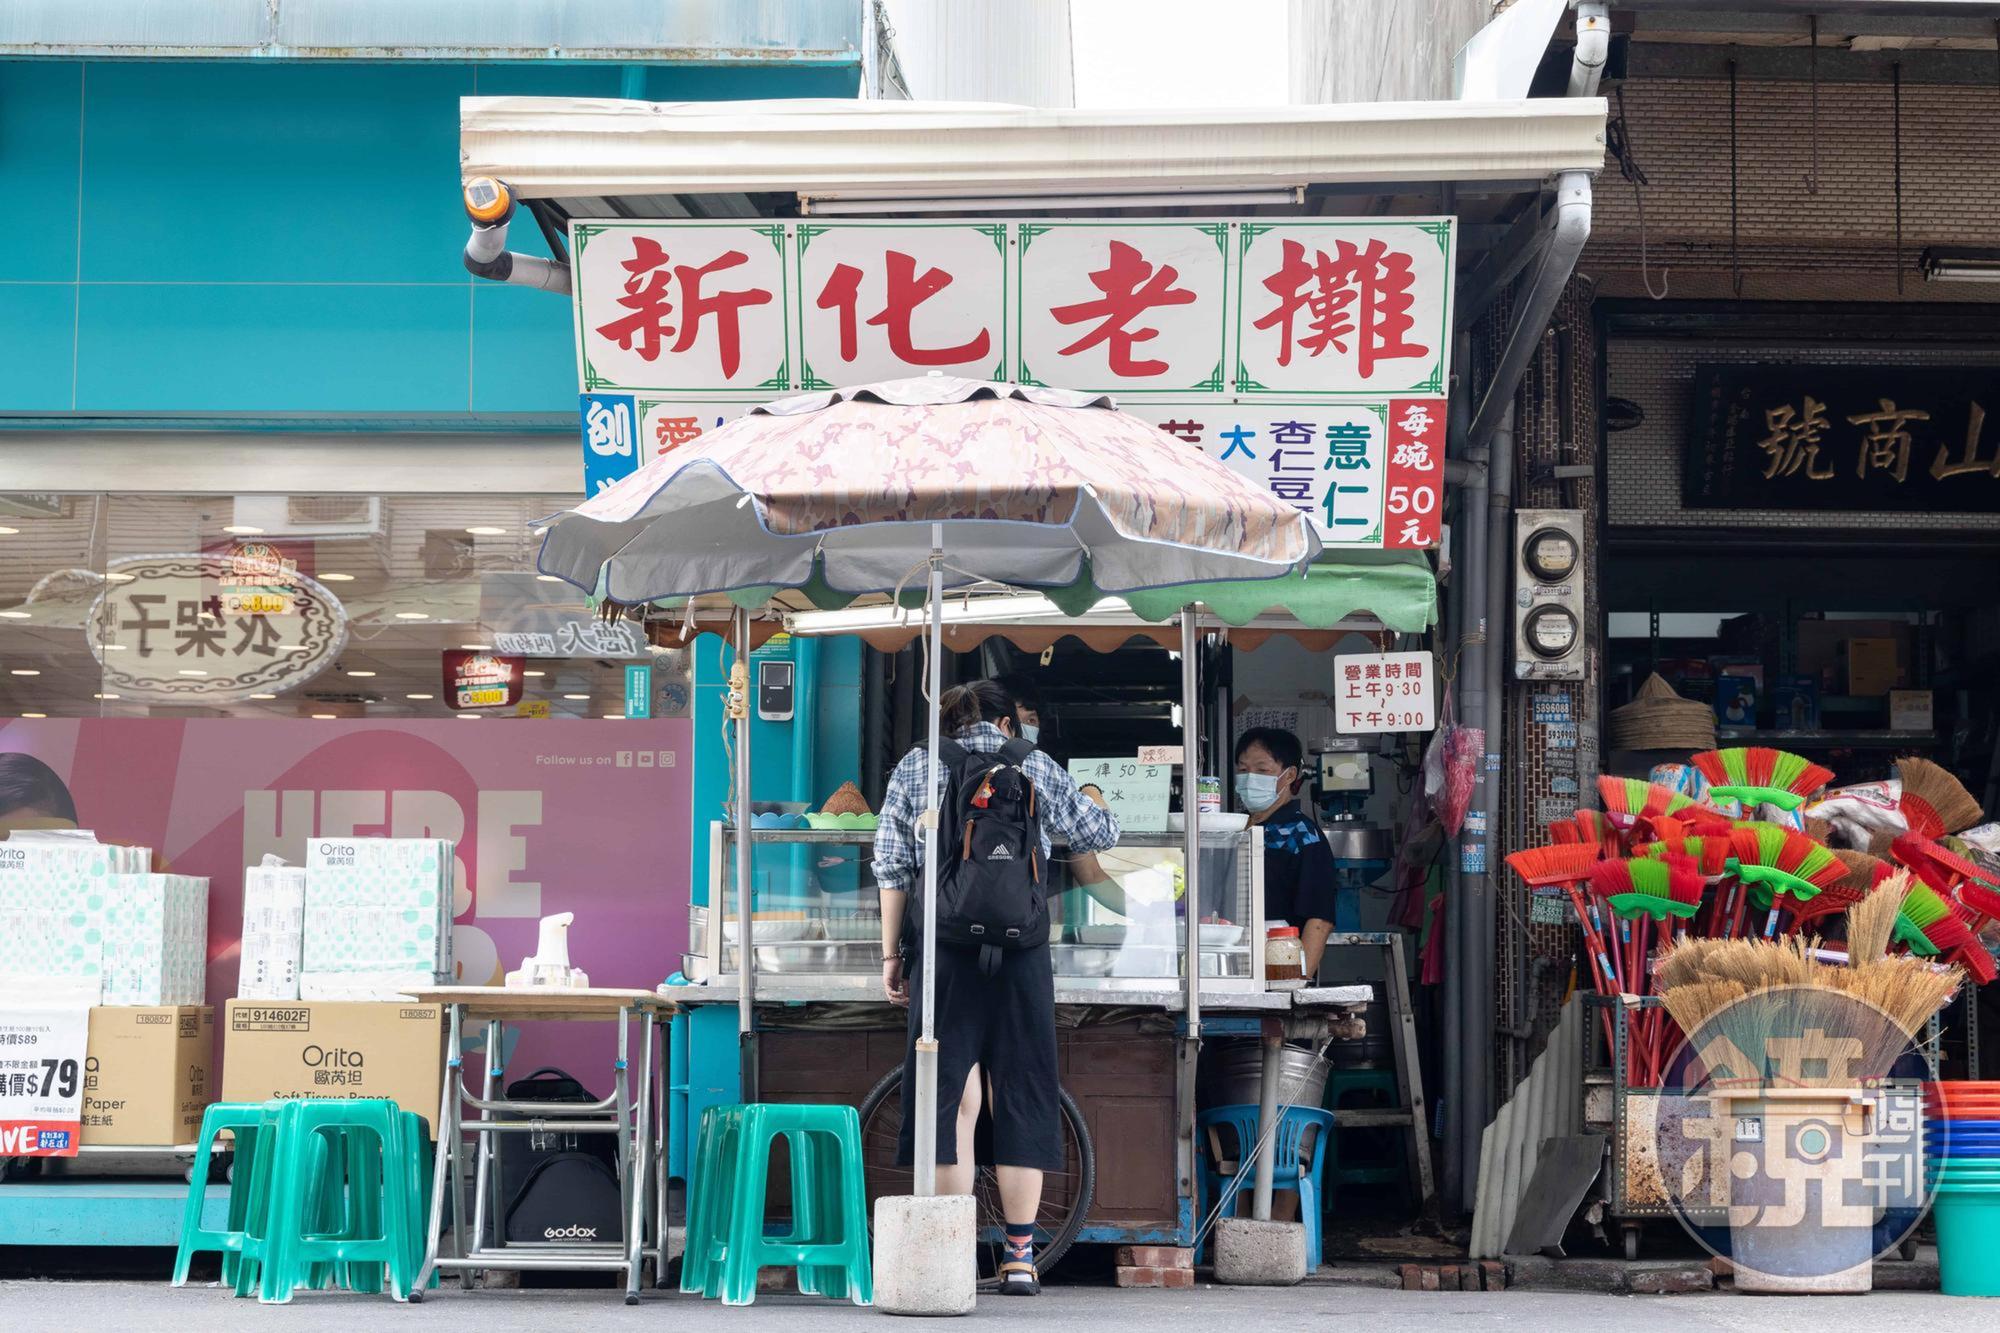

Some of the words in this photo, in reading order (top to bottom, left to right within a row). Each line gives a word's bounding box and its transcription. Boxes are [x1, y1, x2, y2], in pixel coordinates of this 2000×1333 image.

[596, 236, 1430, 381] 新化老攤
[1219, 424, 1256, 461] 大
[1268, 420, 1317, 513] 杏仁豆
[1322, 421, 1372, 529] 意仁
[1344, 662, 1422, 681] 營業時間
[536, 755, 576, 765] Follow
[579, 757, 593, 765] us
[596, 757, 611, 765] on
[1077, 763, 1159, 779] 一律50元
[320, 843, 354, 856] Orita
[253, 1010, 307, 1021] 914602F
[302, 1045, 364, 1068] Orita
[314, 1070, 363, 1085] 歐芮坦
[84, 1097, 126, 1112] Paper
[544, 1224, 596, 1238] Godox
